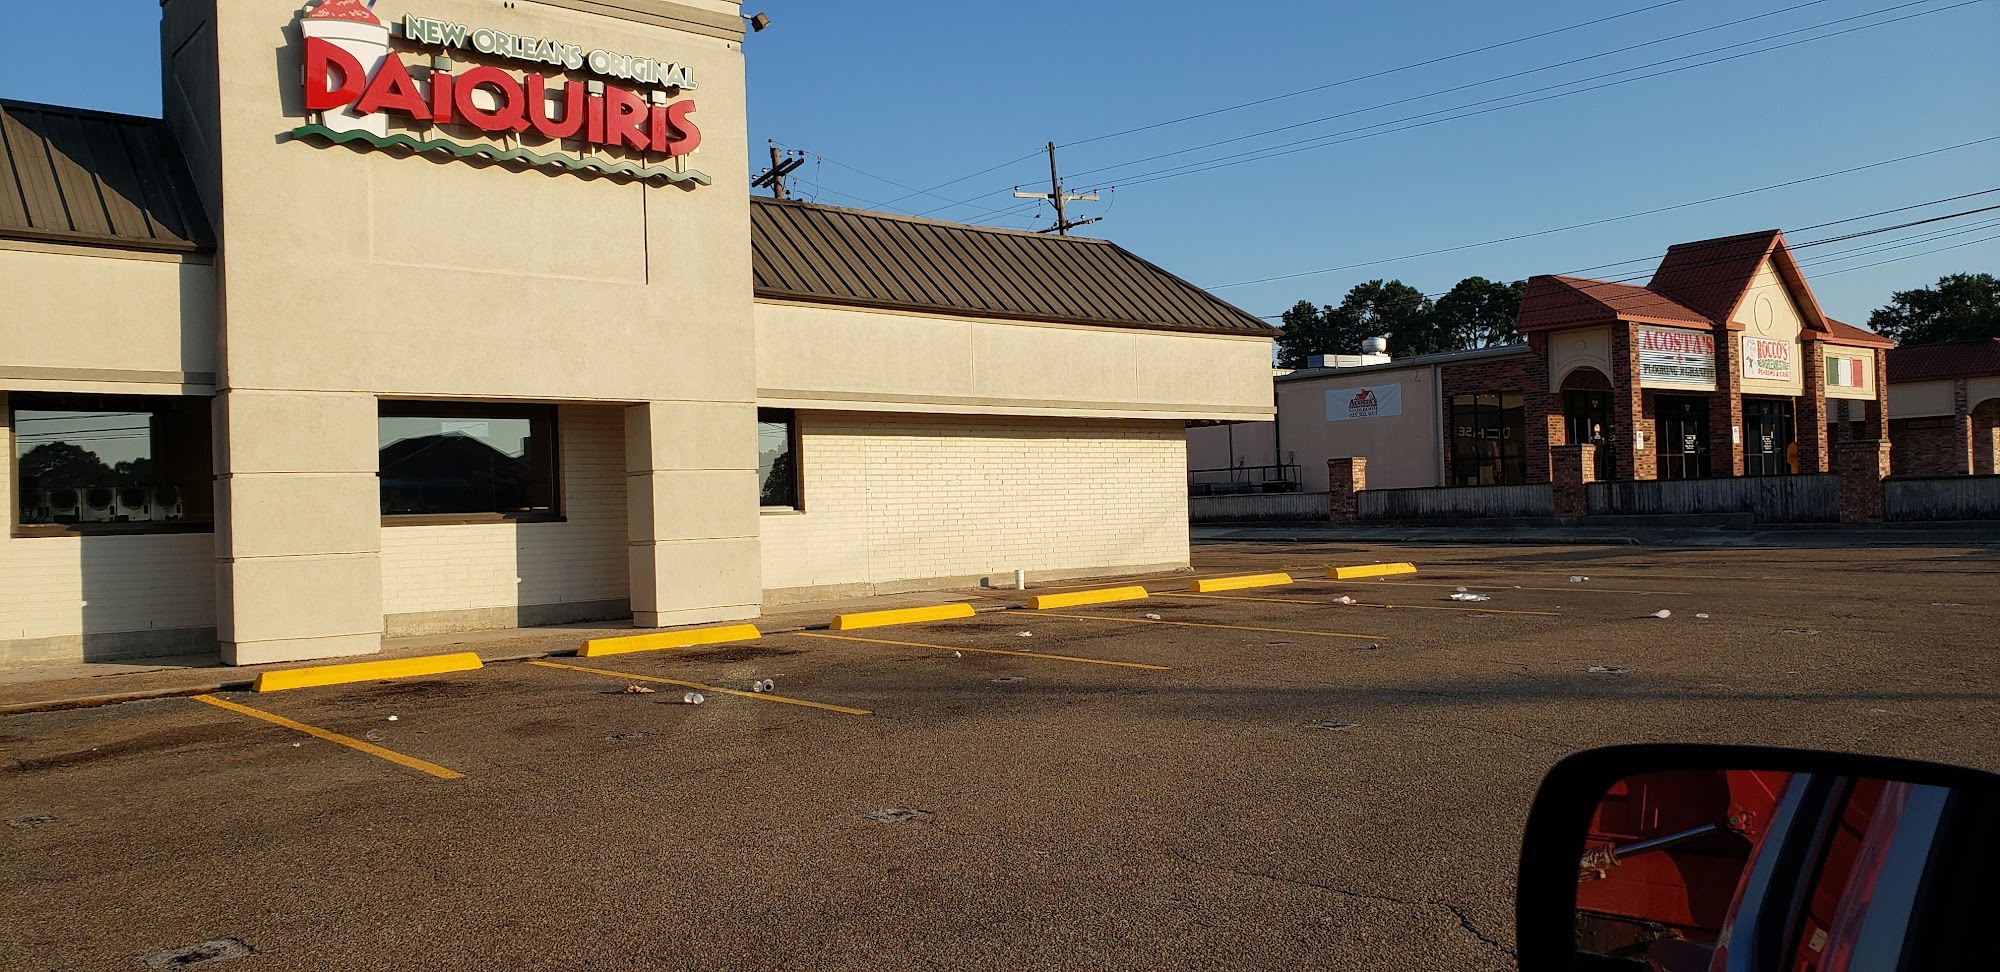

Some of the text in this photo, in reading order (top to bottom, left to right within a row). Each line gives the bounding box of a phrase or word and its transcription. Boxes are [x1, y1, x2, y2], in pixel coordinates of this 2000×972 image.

[405, 13, 699, 90] NEW ORLEANS ORIGINAL
[1642, 330, 1714, 355] ACOSTA'S
[1757, 340, 1788, 361] ROCCO'S
[1349, 398, 1378, 406] ACOSTA'S
